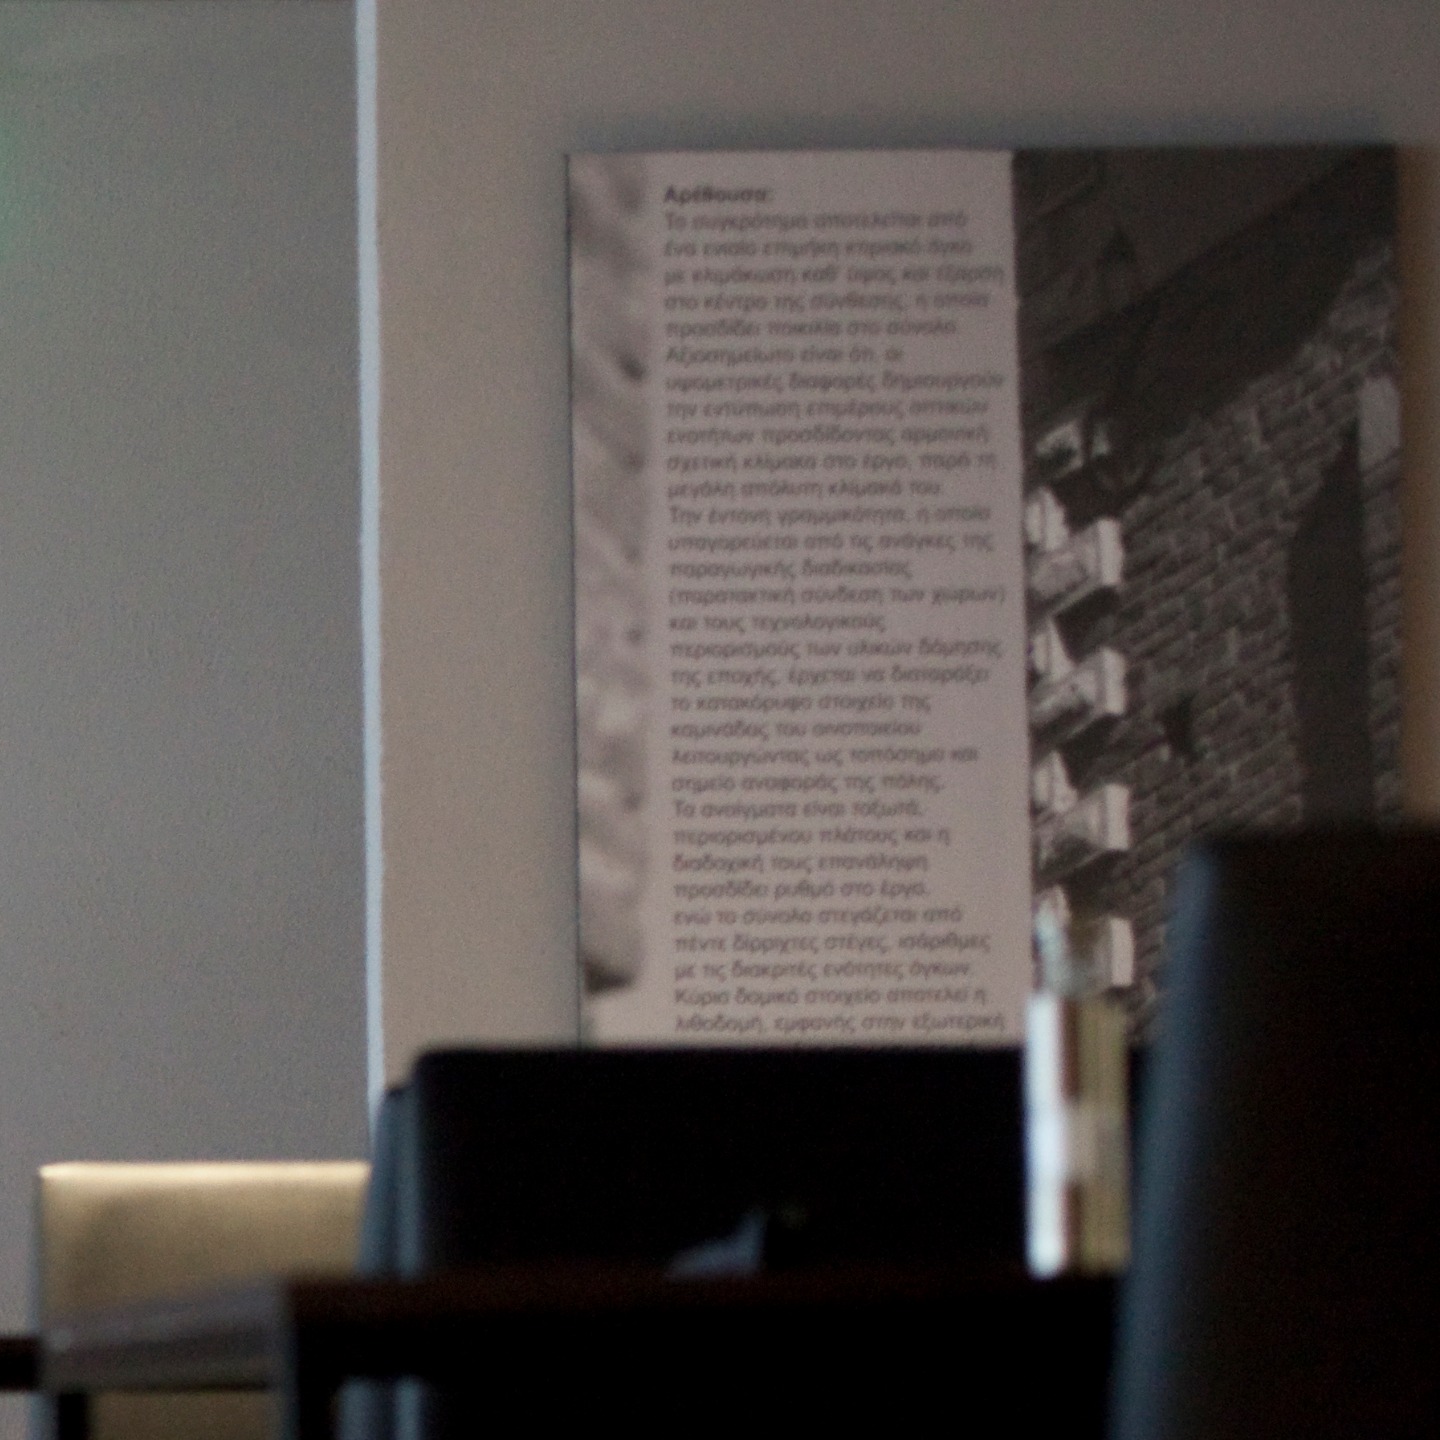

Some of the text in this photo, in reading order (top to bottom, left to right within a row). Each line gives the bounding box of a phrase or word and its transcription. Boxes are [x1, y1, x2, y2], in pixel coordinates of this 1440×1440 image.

[665, 210, 969, 232] Το συγκρότημα αποτελείται από
[662, 238, 698, 255] ένα
[702, 238, 757, 255] ενιαίο
[762, 238, 840, 259] επιμήκη
[927, 237, 973, 258] όγκο
[663, 269, 686, 287] με
[691, 266, 796, 287] κλιμάκωση
[847, 265, 896, 286] ύψος
[901, 268, 930, 282] και
[663, 295, 699, 309] στο
[703, 292, 768, 313] κέντρο
[774, 295, 804, 313] της
[915, 294, 928, 312] η
[665, 318, 760, 339] προσδίδει
[767, 317, 842, 334] ποικιλία
[847, 320, 881, 334] στο
[665, 346, 795, 367] Αξιοσημείωτο
[800, 345, 844, 362] είναι
[884, 348, 904, 362] οι
[665, 372, 1003, 394] υψομετρικές διαφορές δημιουργούν
[666, 402, 698, 420] την
[702, 399, 801, 420] εντύπωση
[806, 398, 903, 419] επιμέρους
[665, 424, 990, 446] ενοτήτων προσδίδοντας αρμονική
[665, 452, 738, 473] σχετική
[742, 452, 817, 473] κλίμακα
[823, 454, 857, 468] στο
[920, 451, 972, 472] παρά
[976, 453, 998, 471] τη
[666, 479, 736, 500] μεγάλη
[740, 479, 823, 500] απόλυτη
[827, 478, 903, 499] κλίμακά
[669, 506, 702, 527] Την
[707, 506, 771, 527] έντονη
[916, 508, 931, 526] η
[666, 531, 995, 553] υπαγορεύεται από τις ανάγκες της
[668, 558, 912, 580] παραγωγικής διαδικασίας
[667, 583, 1007, 606] (παρατακτική σύνδεση των χώρων)
[667, 612, 886, 634] και τους τεχνολογικούς
[669, 639, 1004, 661] περιορισμούς των υλικών δόμησης
[670, 669, 701, 687] της
[787, 665, 856, 686] έρχεται
[862, 668, 886, 682] να
[890, 665, 991, 686] διαταράξει
[670, 692, 932, 714] το κατακόρυφο στοιχείο της
[669, 719, 922, 741] καμινάδας του οινοποιείου
[670, 746, 978, 768] λειτουργώντας ως τοπόσημο και
[670, 773, 736, 794] σημείο
[740, 773, 838, 794] αναφοράς
[844, 775, 875, 793] της
[673, 800, 697, 817] Τα
[700, 800, 798, 821] ανοίγματα
[802, 799, 846, 816] είναι
[672, 825, 953, 847] περιορισμένου πλάτους και η
[671, 852, 930, 874] διαδοχική τους επανάληψη
[673, 880, 769, 901] προσδίδει
[773, 879, 835, 900] ρυθμό
[840, 882, 874, 896] στο
[672, 906, 964, 927] ενώ το σύνολο στεγάζεται από
[673, 933, 726, 950] πέντε
[732, 933, 819, 954] δίρριχτες
[897, 932, 993, 953] ισάριθμες
[673, 963, 696, 981] με
[702, 963, 726, 981] τις
[731, 960, 817, 981] διακριτές
[822, 959, 904, 980] ενότητες
[734, 987, 799, 1008] δομικό
[804, 986, 881, 1007] στοιχείο
[886, 986, 969, 1003] αποτελεί
[973, 988, 988, 1006] η
[776, 1012, 856, 1033] εμφανής
[864, 1015, 904, 1033] στην
[912, 1012, 1006, 1033] εξωτερική
